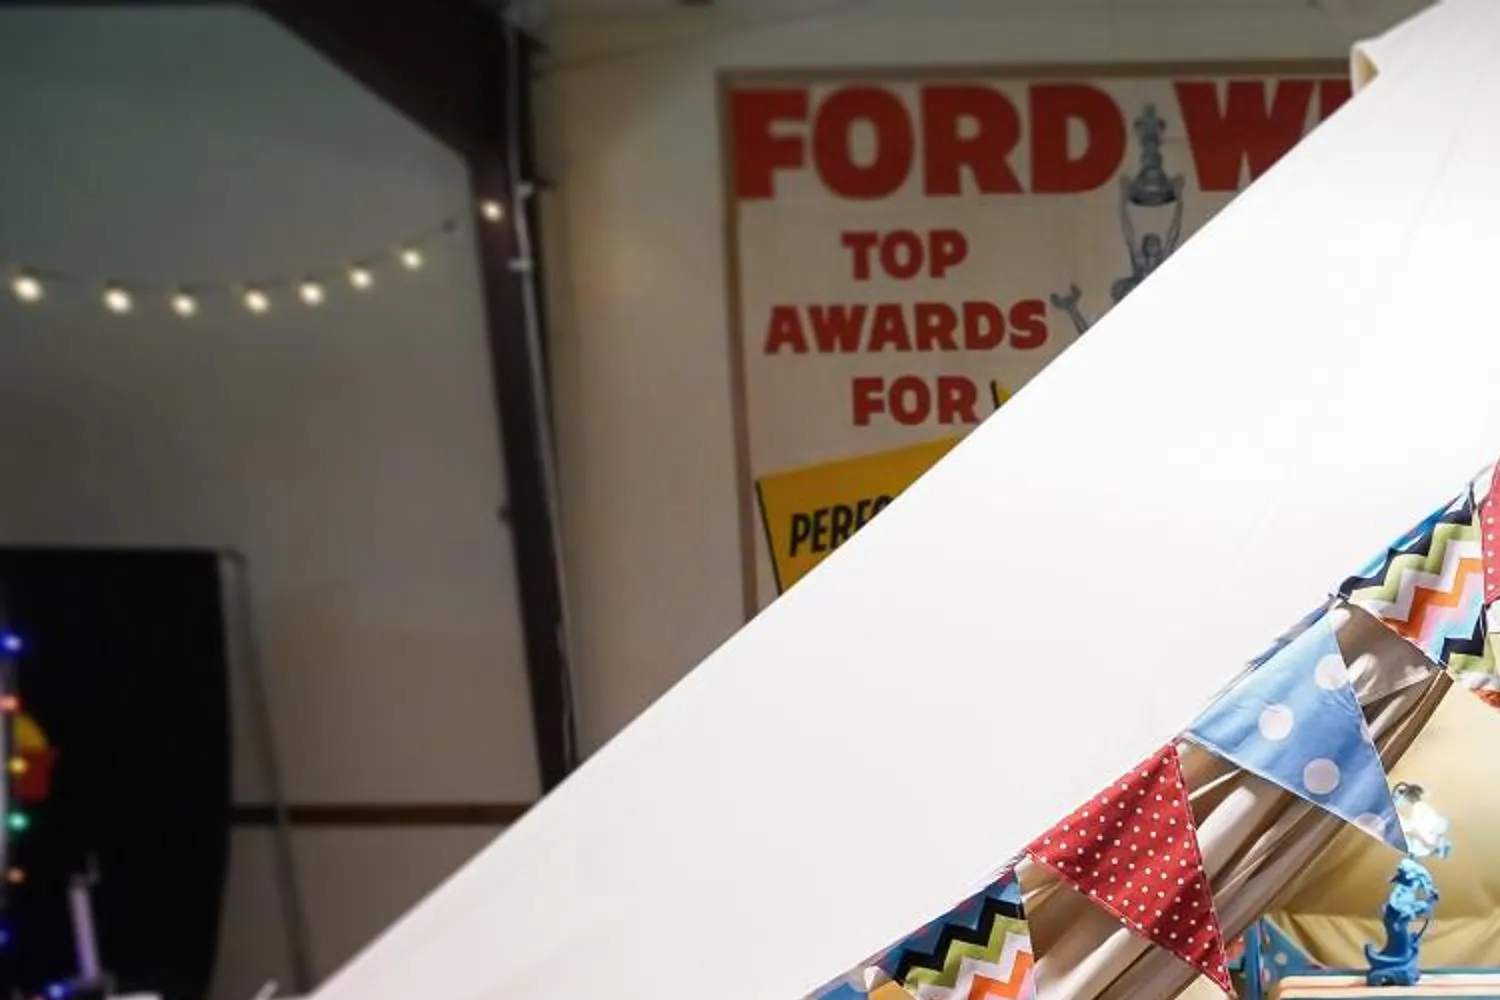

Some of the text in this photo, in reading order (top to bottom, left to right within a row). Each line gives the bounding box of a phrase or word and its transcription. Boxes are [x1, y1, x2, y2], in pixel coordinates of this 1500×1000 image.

[731, 82, 1127, 201] FORD
[841, 229, 968, 281] TOP
[763, 299, 1049, 355] AWARDS
[852, 375, 979, 427] FOR
